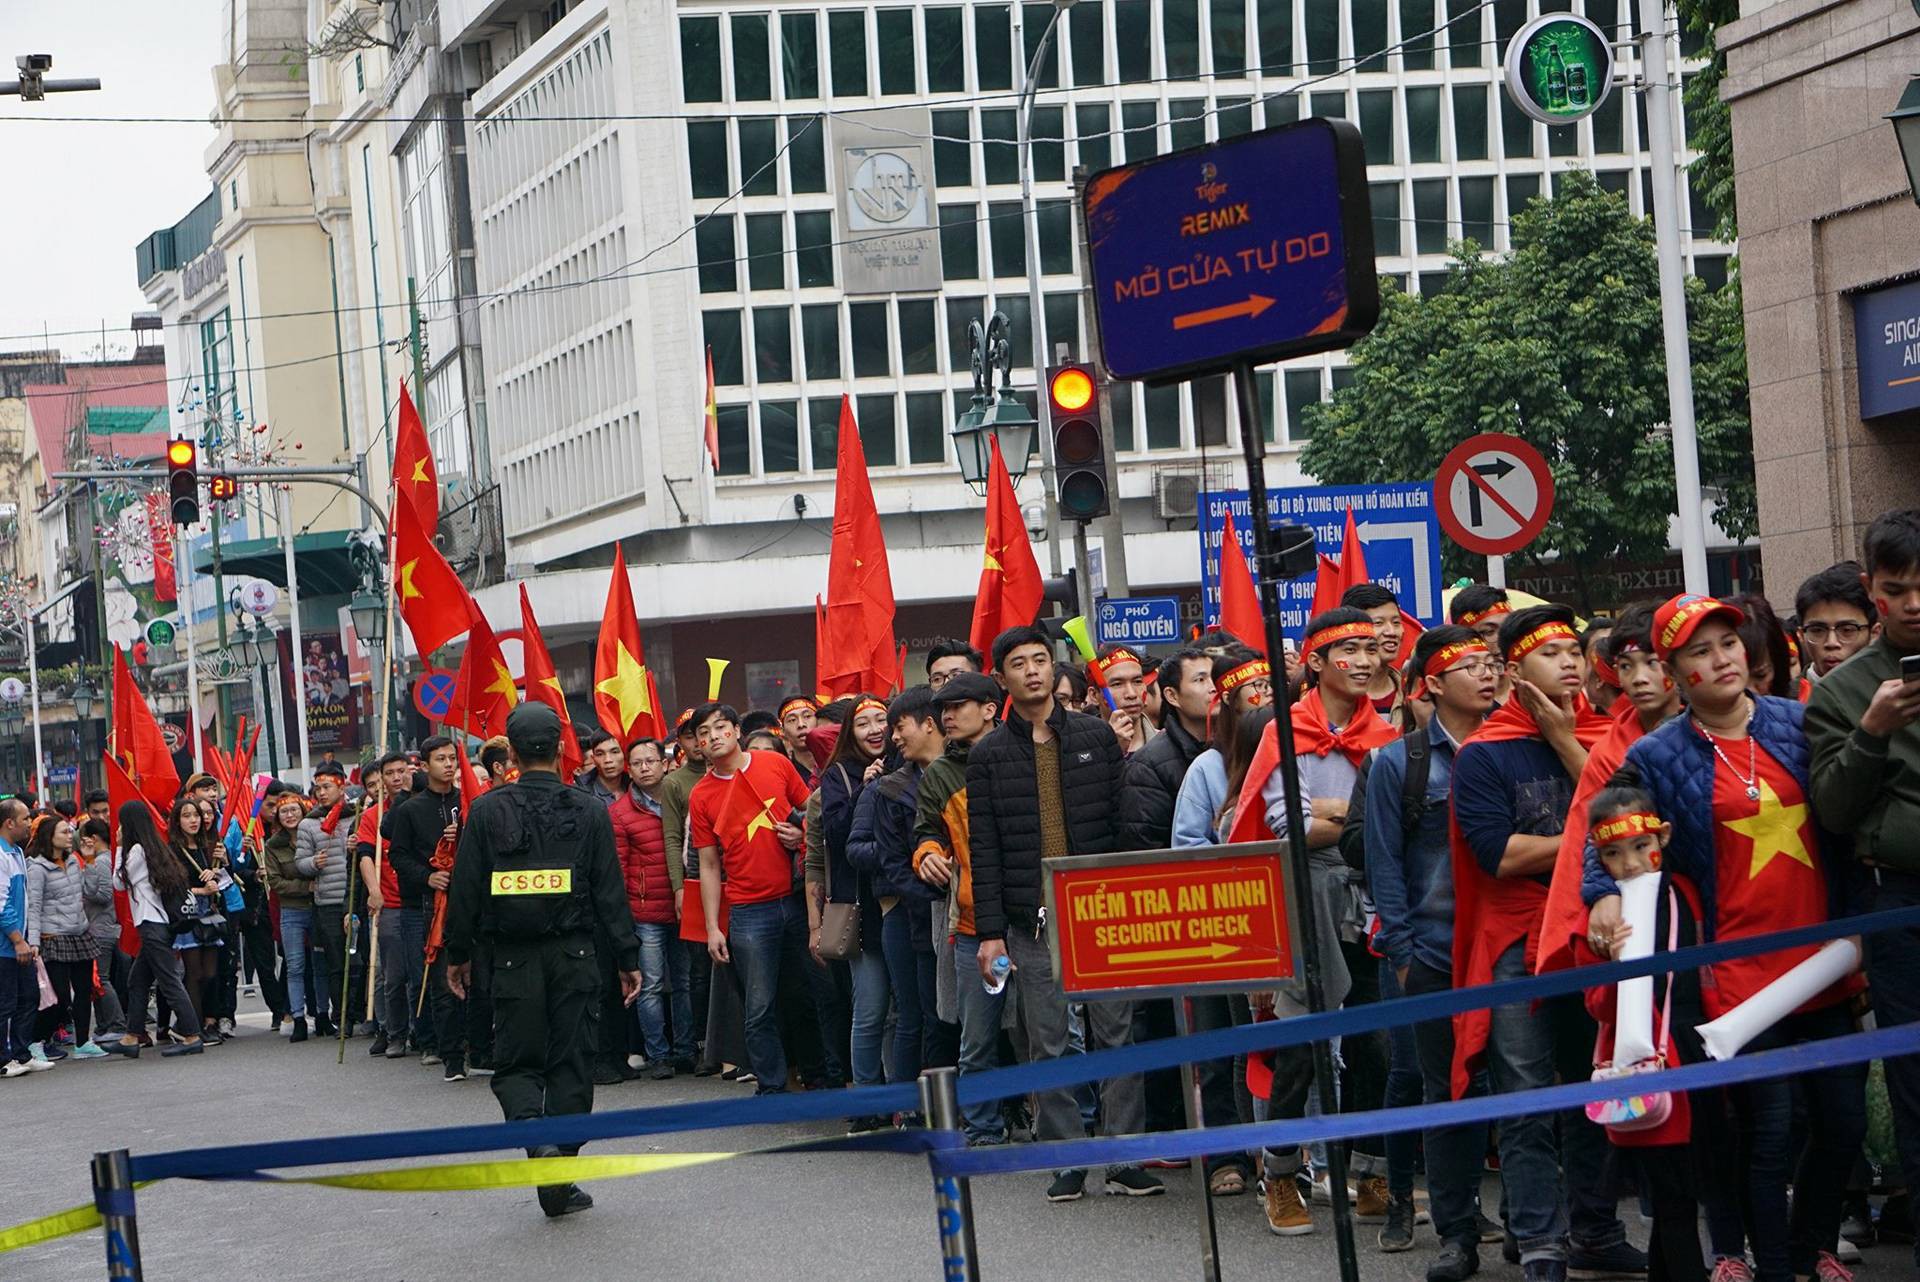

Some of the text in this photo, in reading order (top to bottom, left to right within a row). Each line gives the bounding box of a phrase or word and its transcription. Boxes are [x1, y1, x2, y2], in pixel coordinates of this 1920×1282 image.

[1195, 181, 1228, 203] Tiger
[1181, 203, 1250, 237] REMIX
[1114, 232, 1330, 302] MỞ CỬA TỰ DO
[1903, 342, 1920, 367] AI
[214, 479, 234, 495] 21
[1230, 497, 1253, 516] TUYẾ
[1281, 498, 1291, 514] ĐI
[1293, 494, 1305, 517] BỘ
[1306, 495, 1332, 513] XUNG
[1379, 489, 1404, 509] HOÀN
[1405, 487, 1428, 507] KIẾM
[1317, 522, 1342, 545] TIỆN
[1290, 582, 1316, 600] 19H0
[1125, 603, 1150, 617] PHỐ
[1280, 603, 1302, 628] CHỦ
[1104, 617, 1130, 639] NGÔ
[1235, 666, 1256, 681] NAM
[499, 873, 563, 891] CSCĐ
[1073, 879, 1268, 922] KIỂM TRA AN NINH
[1095, 913, 1252, 948] SECURITY CHECK
